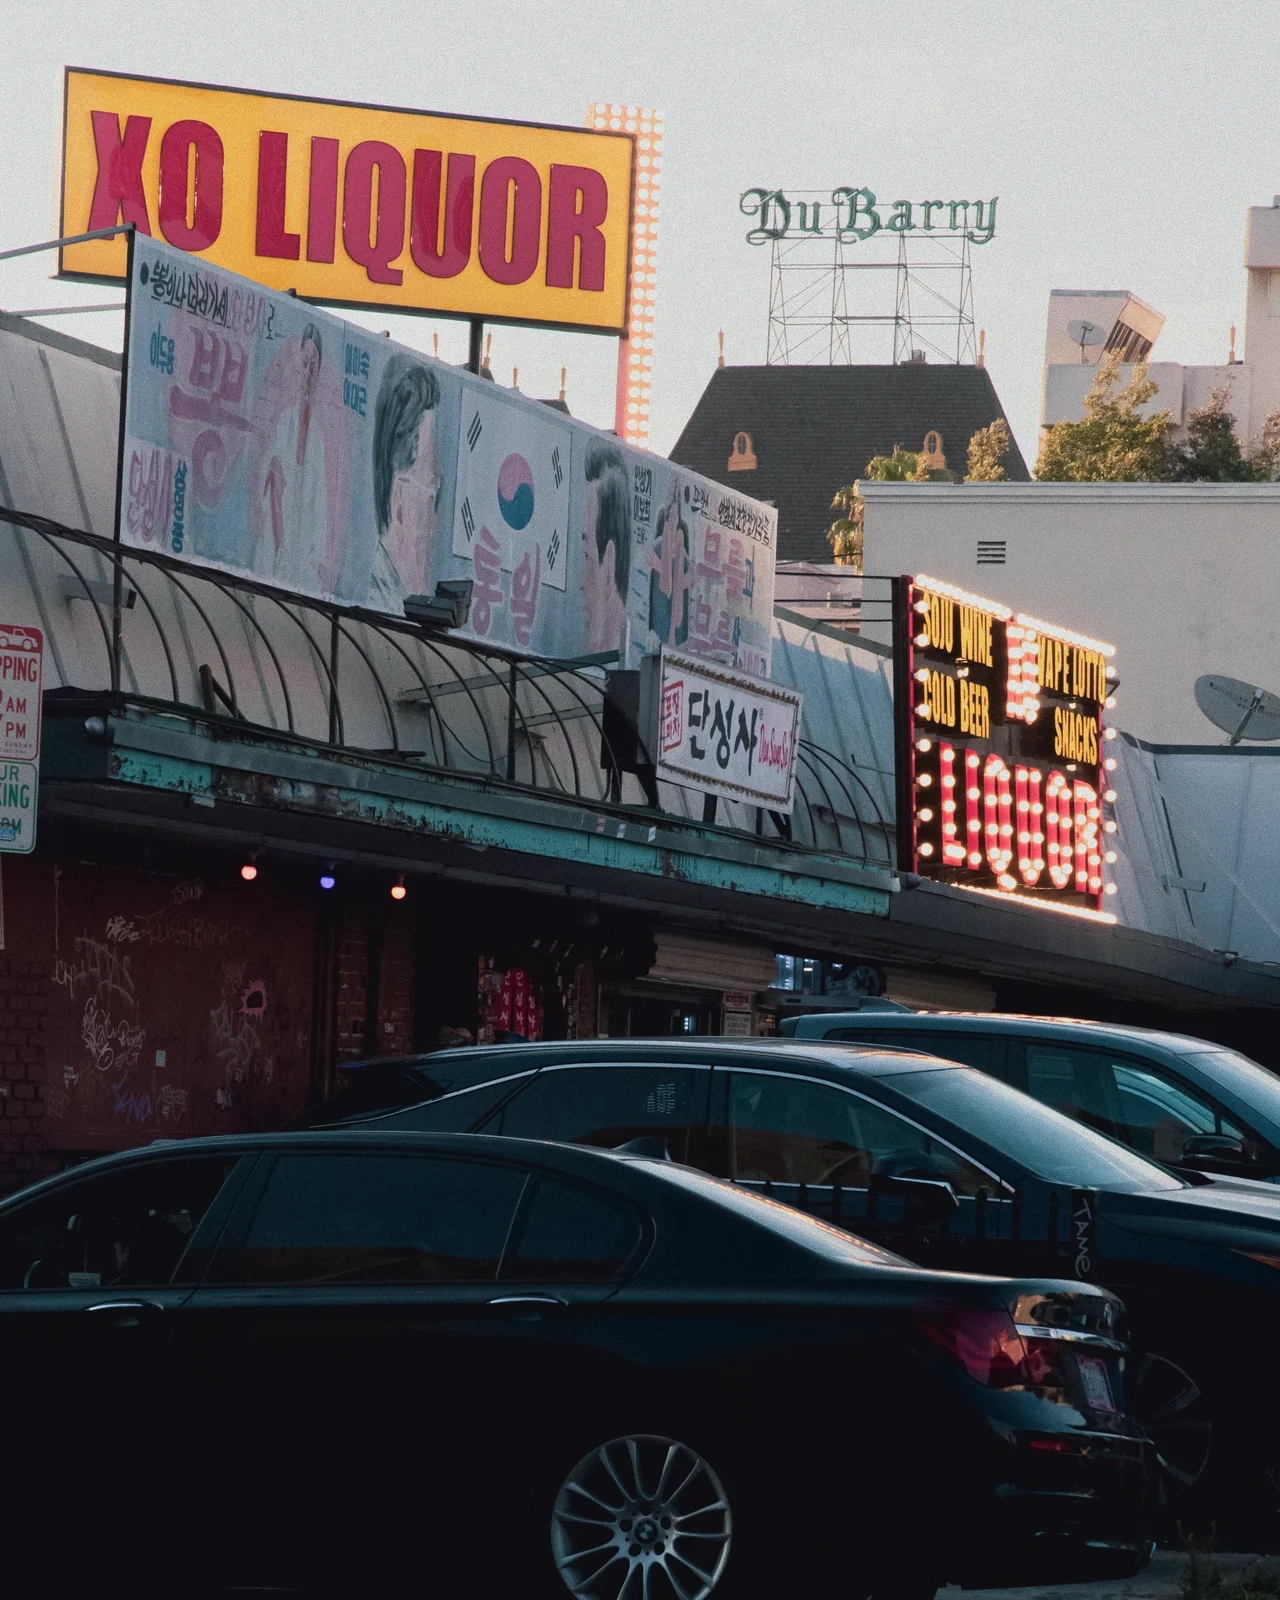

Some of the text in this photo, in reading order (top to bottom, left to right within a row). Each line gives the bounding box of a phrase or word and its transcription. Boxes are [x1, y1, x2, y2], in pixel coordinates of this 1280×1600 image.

[87, 111, 609, 292] XO LIQUOR
[922, 590, 994, 668] SOJU WINE
[0, 655, 38, 683] PING
[923, 667, 990, 739] COLD BEER
[1037, 633, 1107, 703] VAPE LOTTO
[5, 697, 27, 714] AM
[5, 721, 27, 740] PM
[688, 689, 759, 777] 단성사
[1054, 705, 1098, 767] SNACKS
[0, 784, 30, 810] ING
[939, 741, 1099, 896] LIQUOR
